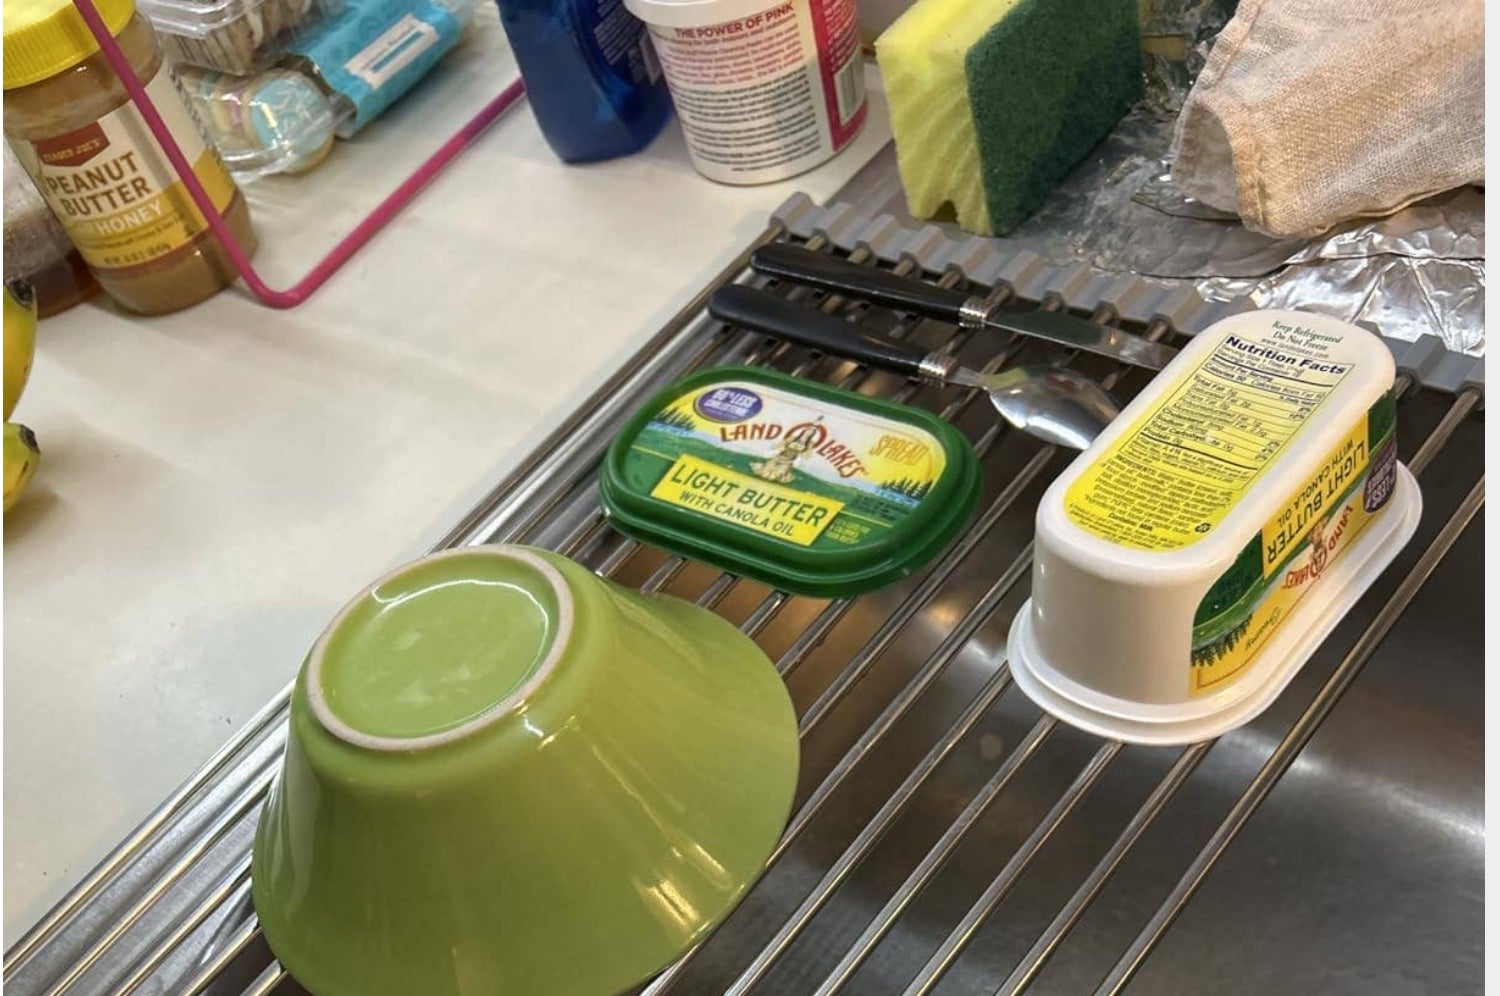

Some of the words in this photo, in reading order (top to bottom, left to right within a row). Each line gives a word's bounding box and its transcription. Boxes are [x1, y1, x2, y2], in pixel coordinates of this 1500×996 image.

[674, 28, 696, 38] THE
[699, 22, 743, 38] POWER
[745, 15, 764, 29] OF
[765, 2, 794, 22] PINK
[46, 151, 139, 194] PEANUT
[59, 177, 152, 216] BUTTER
[96, 200, 162, 235] HONEY
[1272, 321, 1294, 332] Keep
[1293, 327, 1343, 344] Refrigerated
[1272, 332, 1287, 340] Do
[1288, 336, 1303, 345] Not
[1303, 340, 1328, 350] Freeze
[1226, 337, 1297, 364] Nutrition
[1299, 360, 1345, 375] Facts
[731, 393, 757, 409] LESS
[720, 424, 783, 443] LAND
[818, 439, 867, 480] LAKES
[869, 434, 930, 468] SPREAD
[1326, 439, 1367, 500] LIGHT
[1331, 438, 1354, 469] WITH
[671, 464, 737, 498] LIGHT
[737, 488, 828, 528] BUTTER
[1293, 464, 1331, 511] CANOLA
[680, 491, 714, 510] WITH
[715, 503, 769, 529] CANOLA
[773, 521, 795, 537] OIL
[1267, 493, 1323, 565] BUTTER
[1276, 508, 1292, 527] OIL
[1328, 505, 1354, 551] LAND
